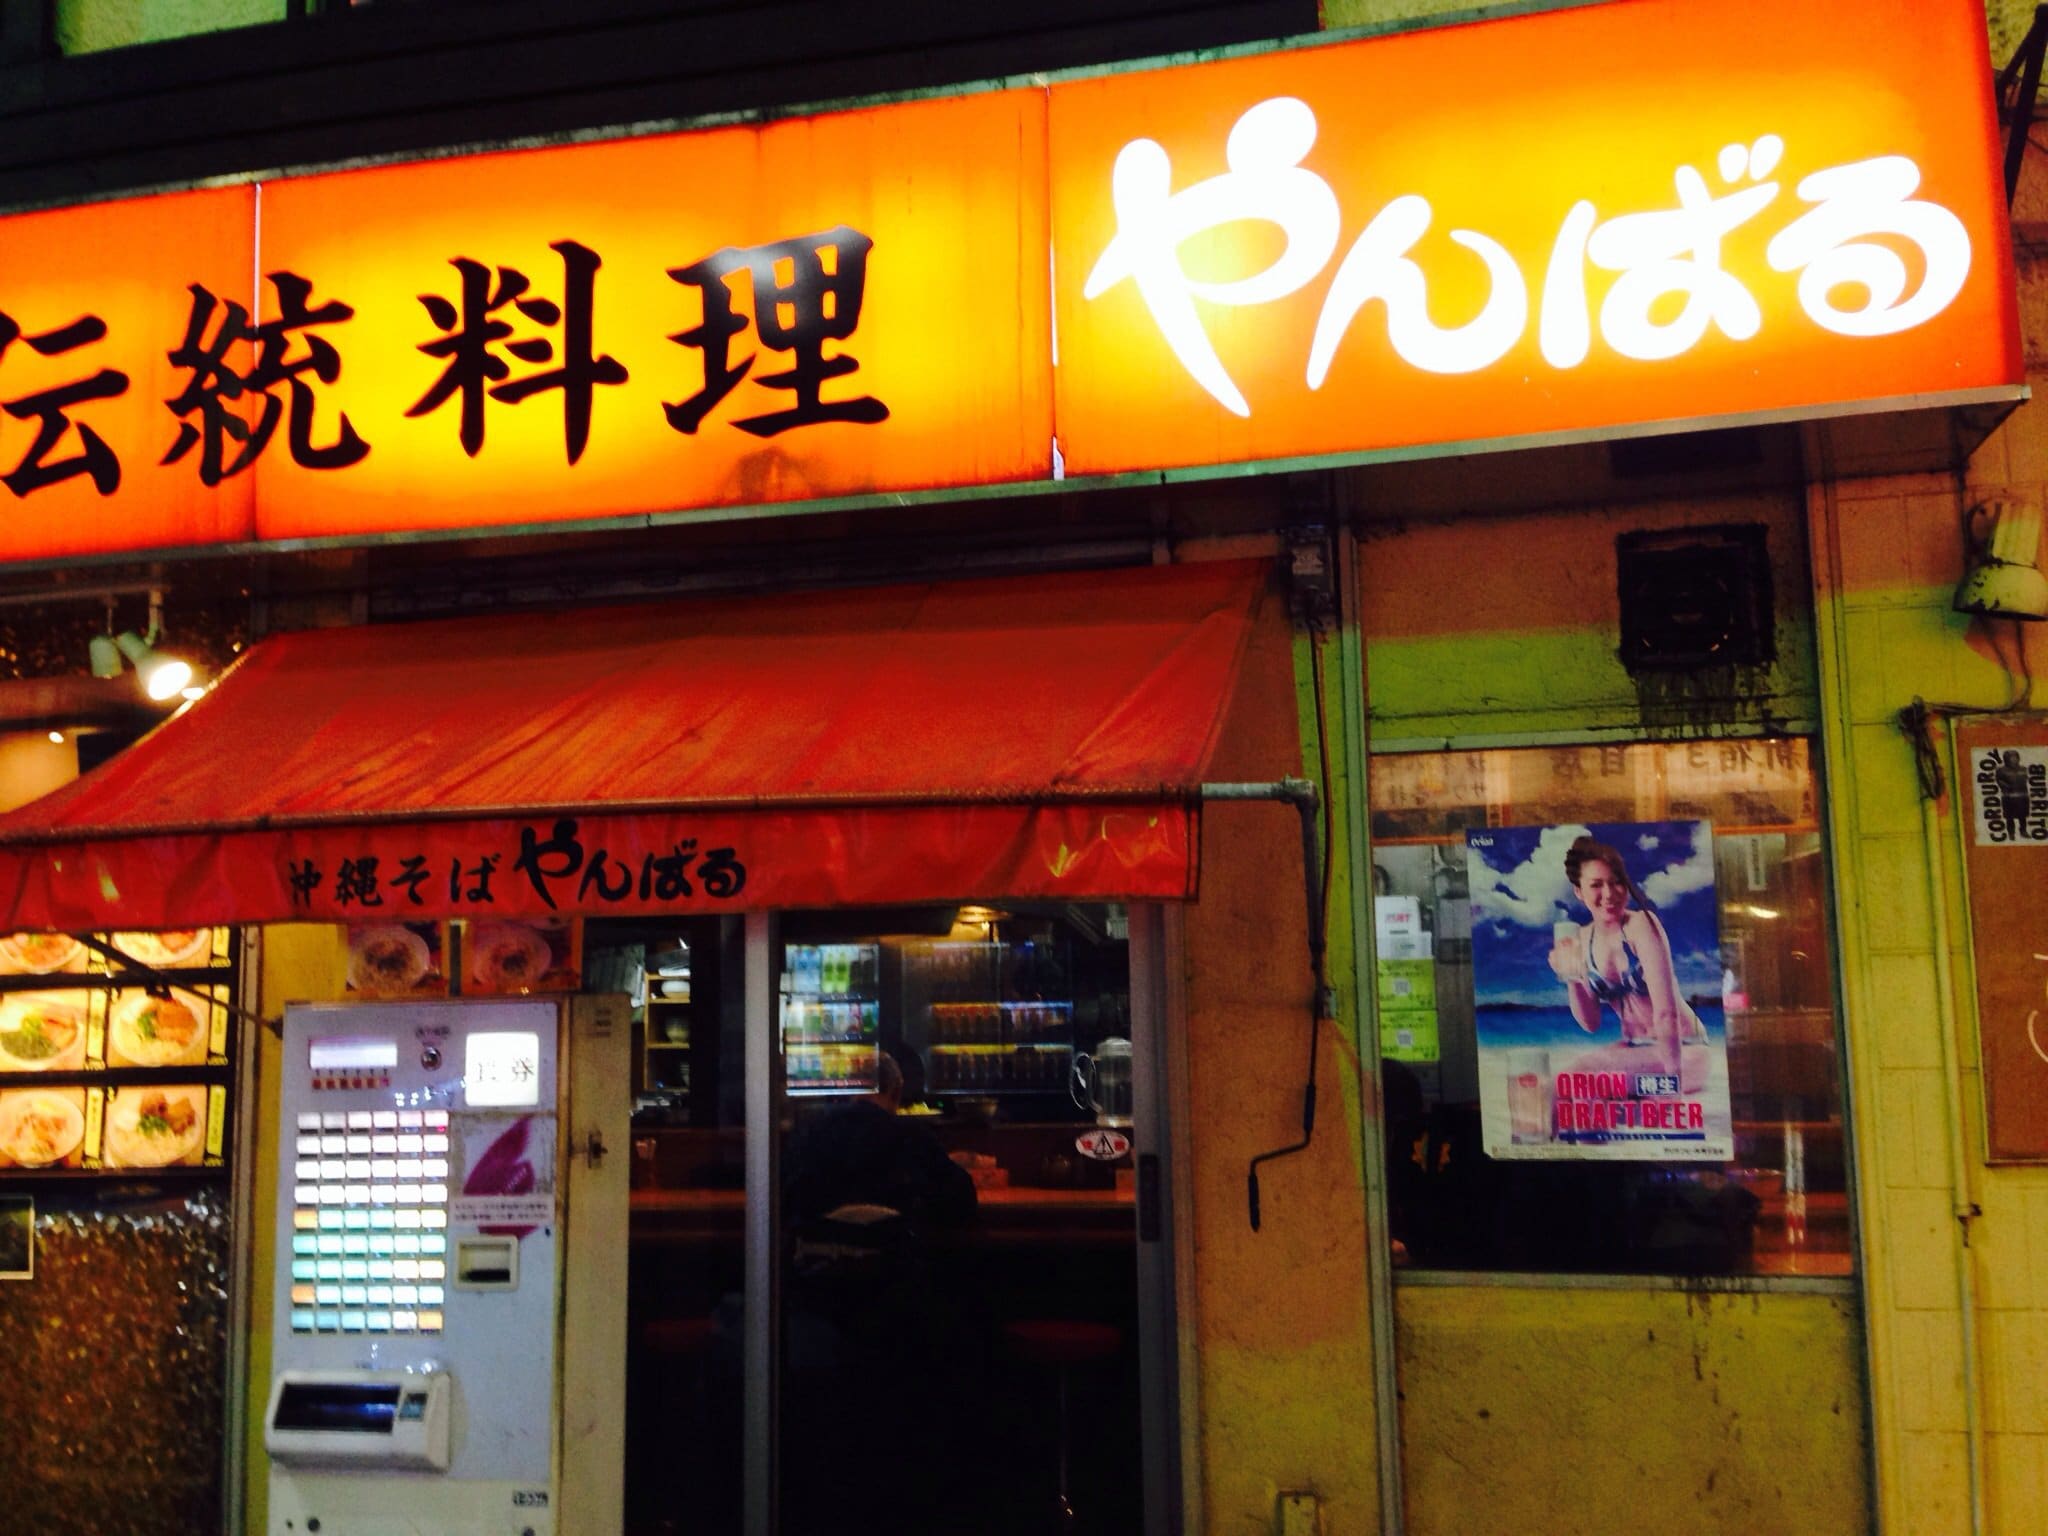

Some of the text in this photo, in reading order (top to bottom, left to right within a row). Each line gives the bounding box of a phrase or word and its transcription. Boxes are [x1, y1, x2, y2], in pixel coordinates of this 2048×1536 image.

[1084, 96, 1972, 419] やんばる
[0, 224, 890, 498] 伝統料理
[1977, 748, 2007, 842] CORDUROY
[2027, 764, 2048, 841] BURRITO
[289, 818, 747, 911] 沖縄そば やんばる
[1556, 1072, 1628, 1100] ORION
[1556, 1101, 1704, 1129] DRAFT BEER
